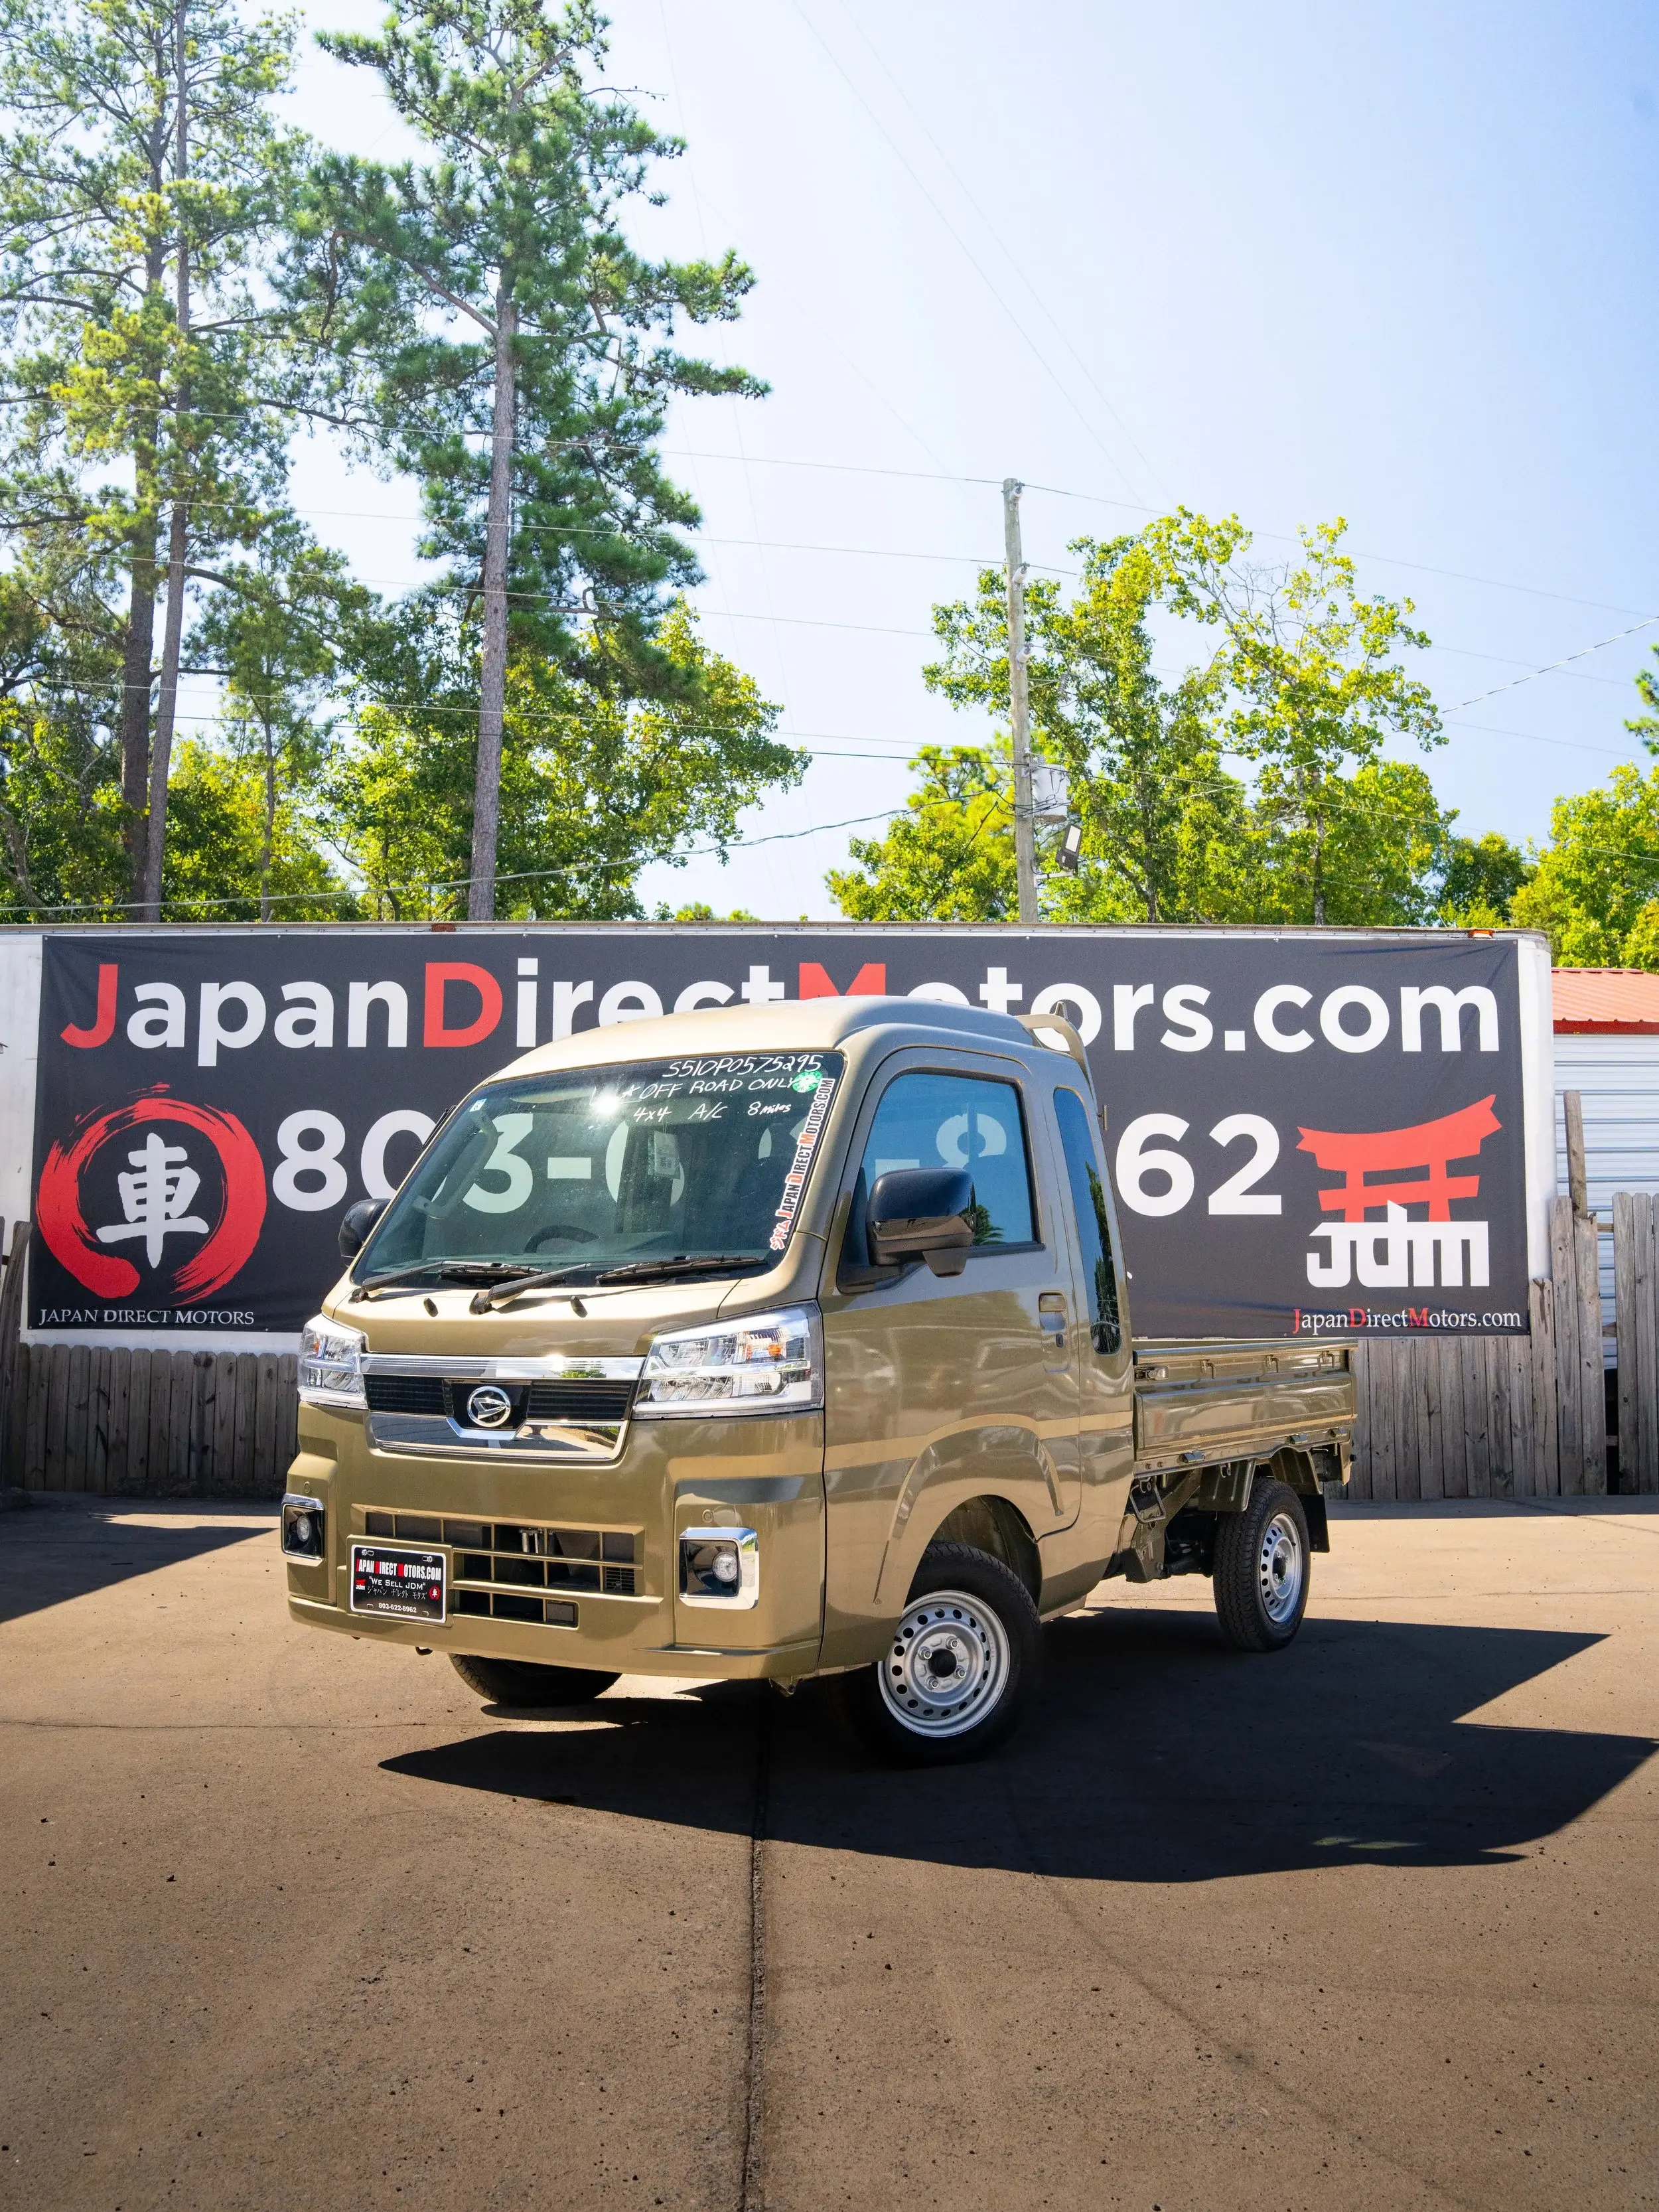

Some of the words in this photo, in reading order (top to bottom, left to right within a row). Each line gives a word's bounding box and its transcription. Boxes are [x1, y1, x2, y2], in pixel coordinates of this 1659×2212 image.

[60, 958, 1499, 1066] JapanDiretors.com
[639, 1082, 683, 1100] OFF
[689, 1079, 743, 1094] ROAD
[749, 1076, 800, 1090] ONLY
[687, 1102, 727, 1120] A/C
[96, 1132, 210, 1268] 車
[38, 1309, 99, 1325] JAPAN
[104, 1309, 171, 1323] DIRECT
[175, 1311, 255, 1325] MOTORS
[1293, 1307, 1522, 1335] JapanDirectMotors.com
[378, 1602, 417, 1613] 803-622-8962
